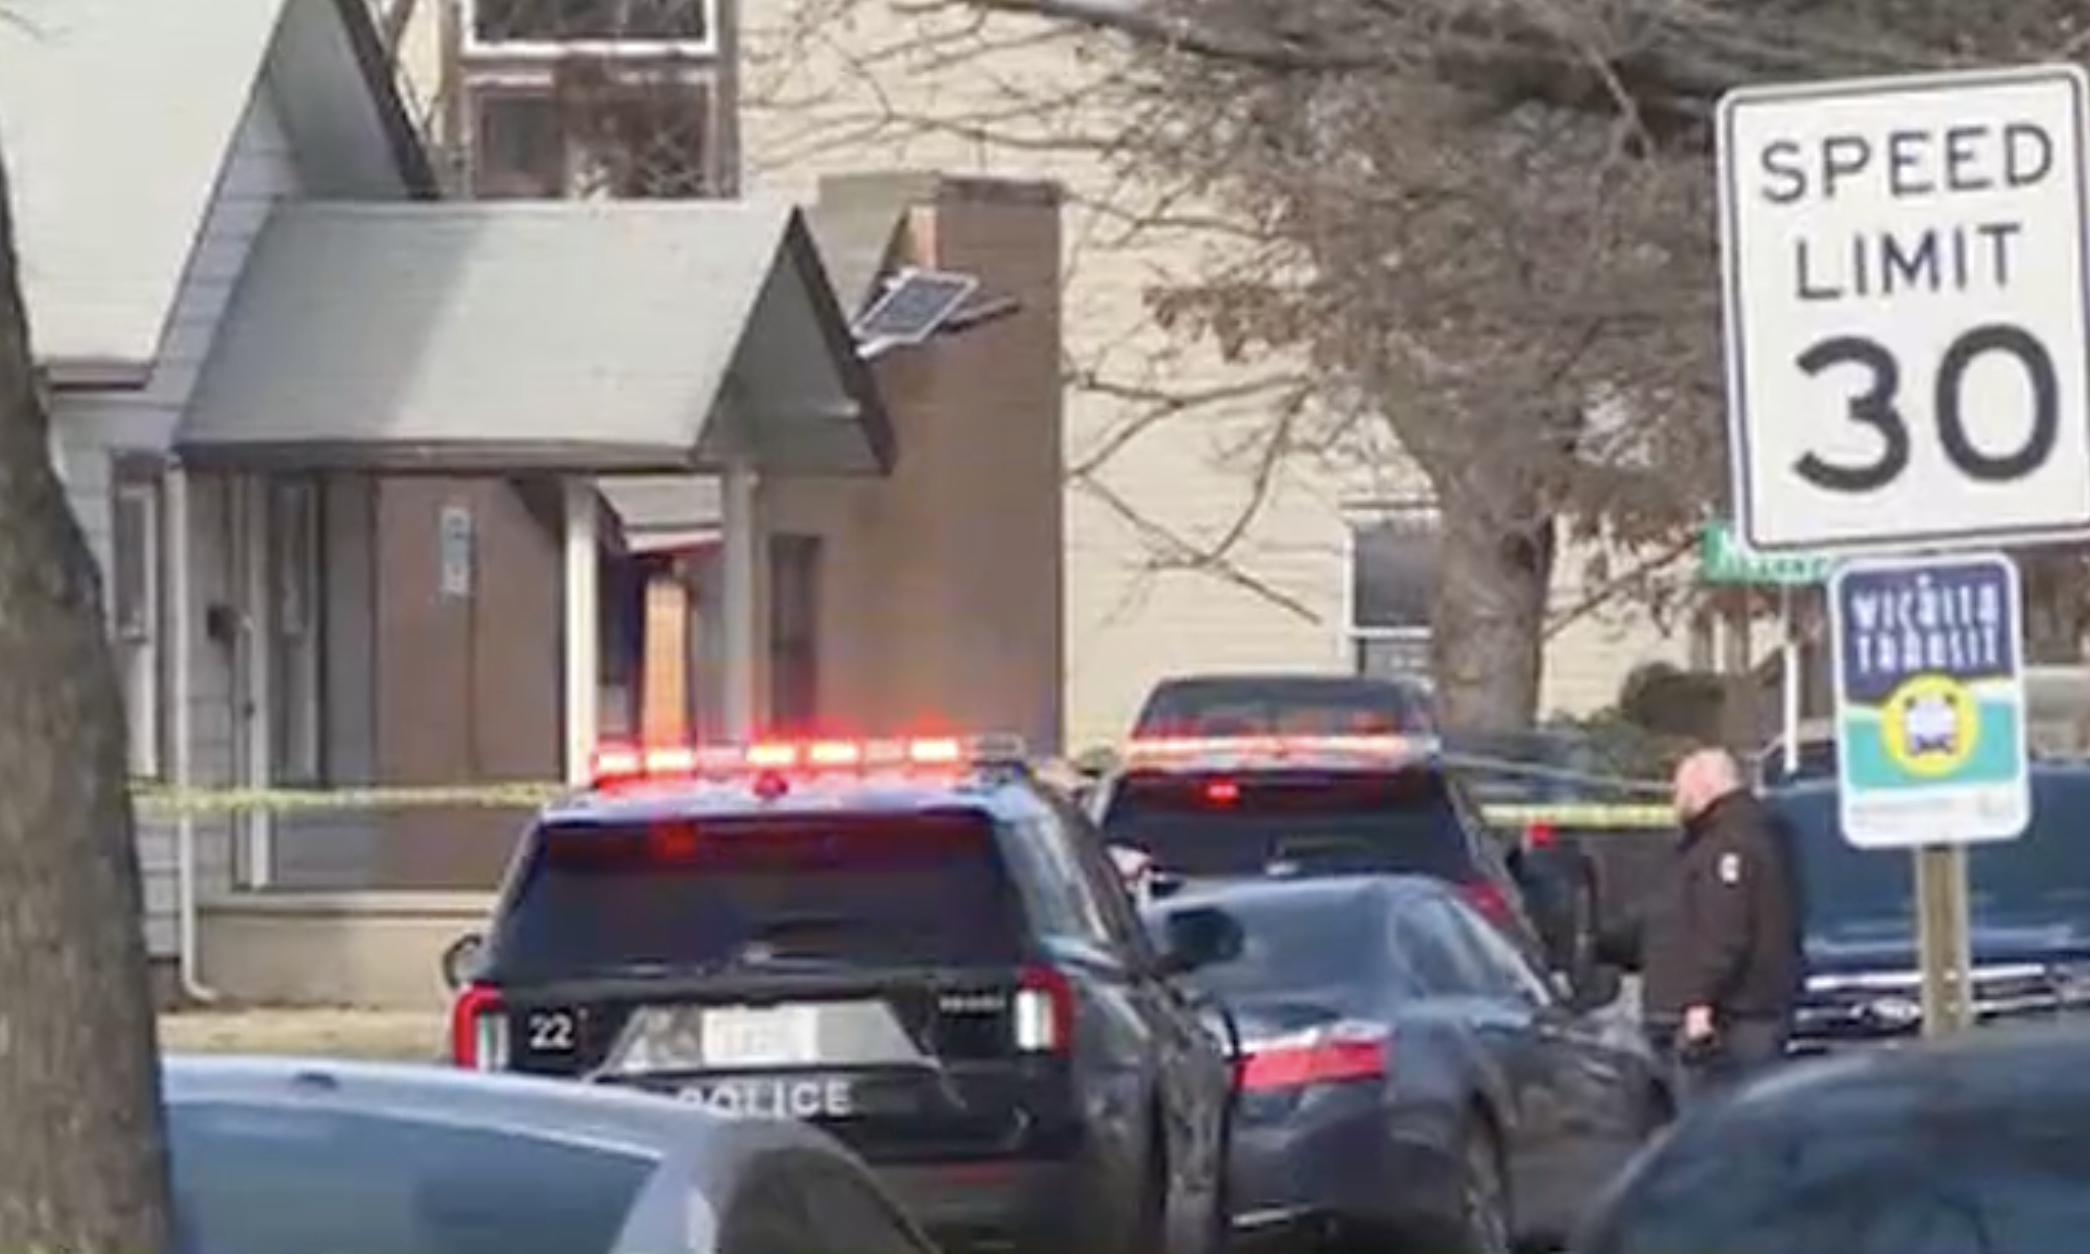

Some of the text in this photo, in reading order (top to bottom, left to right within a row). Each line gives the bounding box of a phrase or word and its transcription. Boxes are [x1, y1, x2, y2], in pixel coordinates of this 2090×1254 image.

[1760, 123, 2053, 203] SPEED
[1794, 223, 2022, 300] LIMIT
[1791, 323, 2059, 493] 30
[529, 1012, 575, 1049] 22
